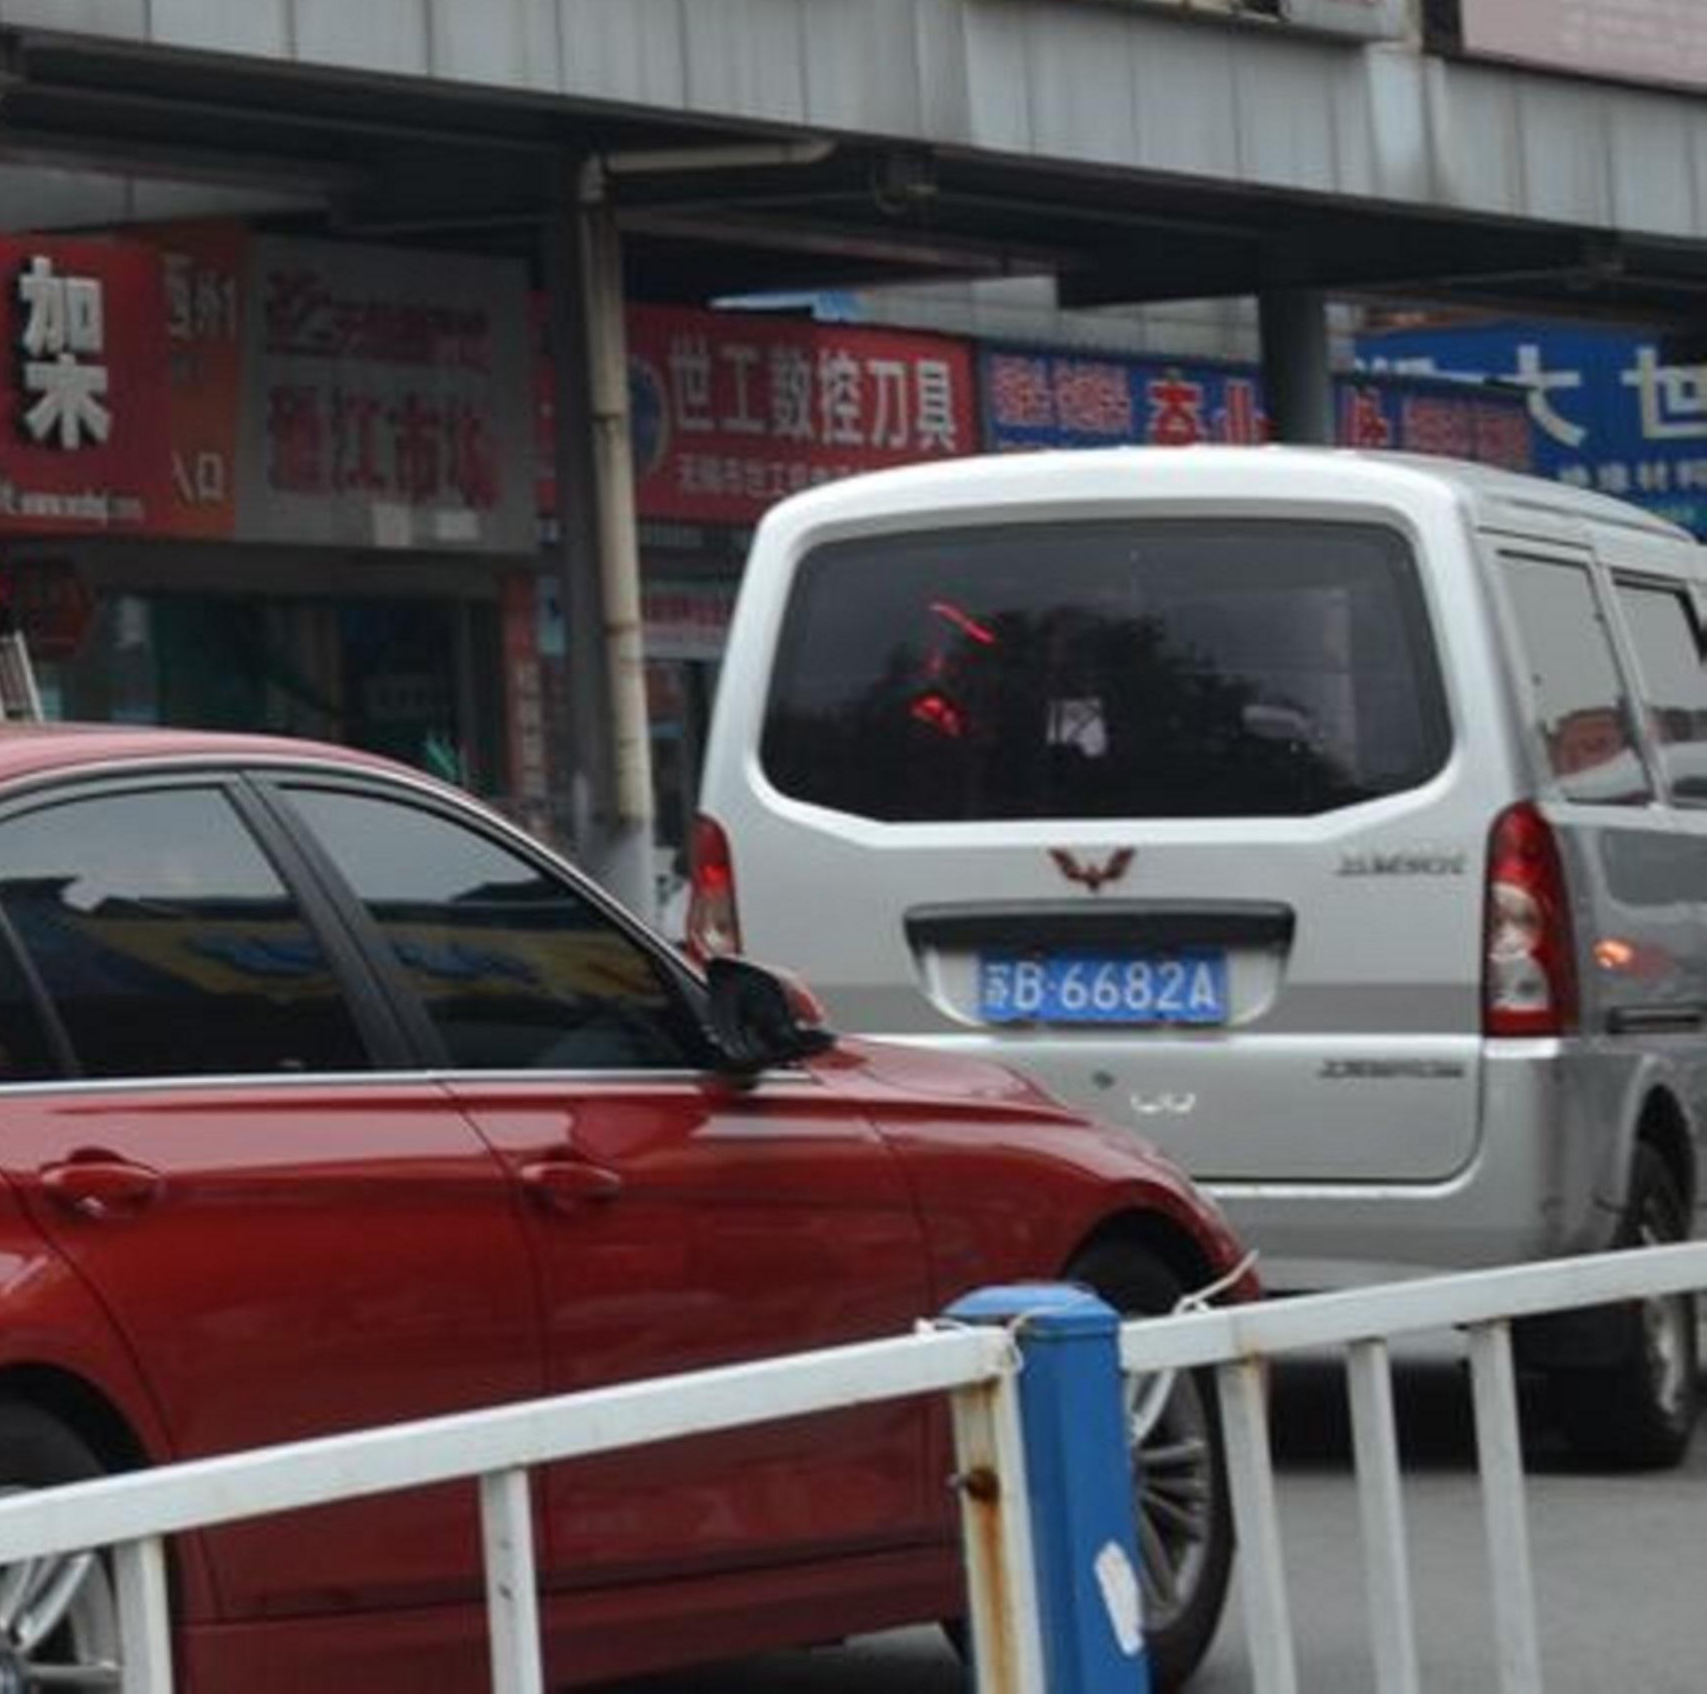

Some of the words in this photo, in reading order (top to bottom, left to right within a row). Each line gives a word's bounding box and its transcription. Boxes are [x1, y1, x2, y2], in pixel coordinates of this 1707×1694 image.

[670, 324, 960, 455] 世工数控刀具
